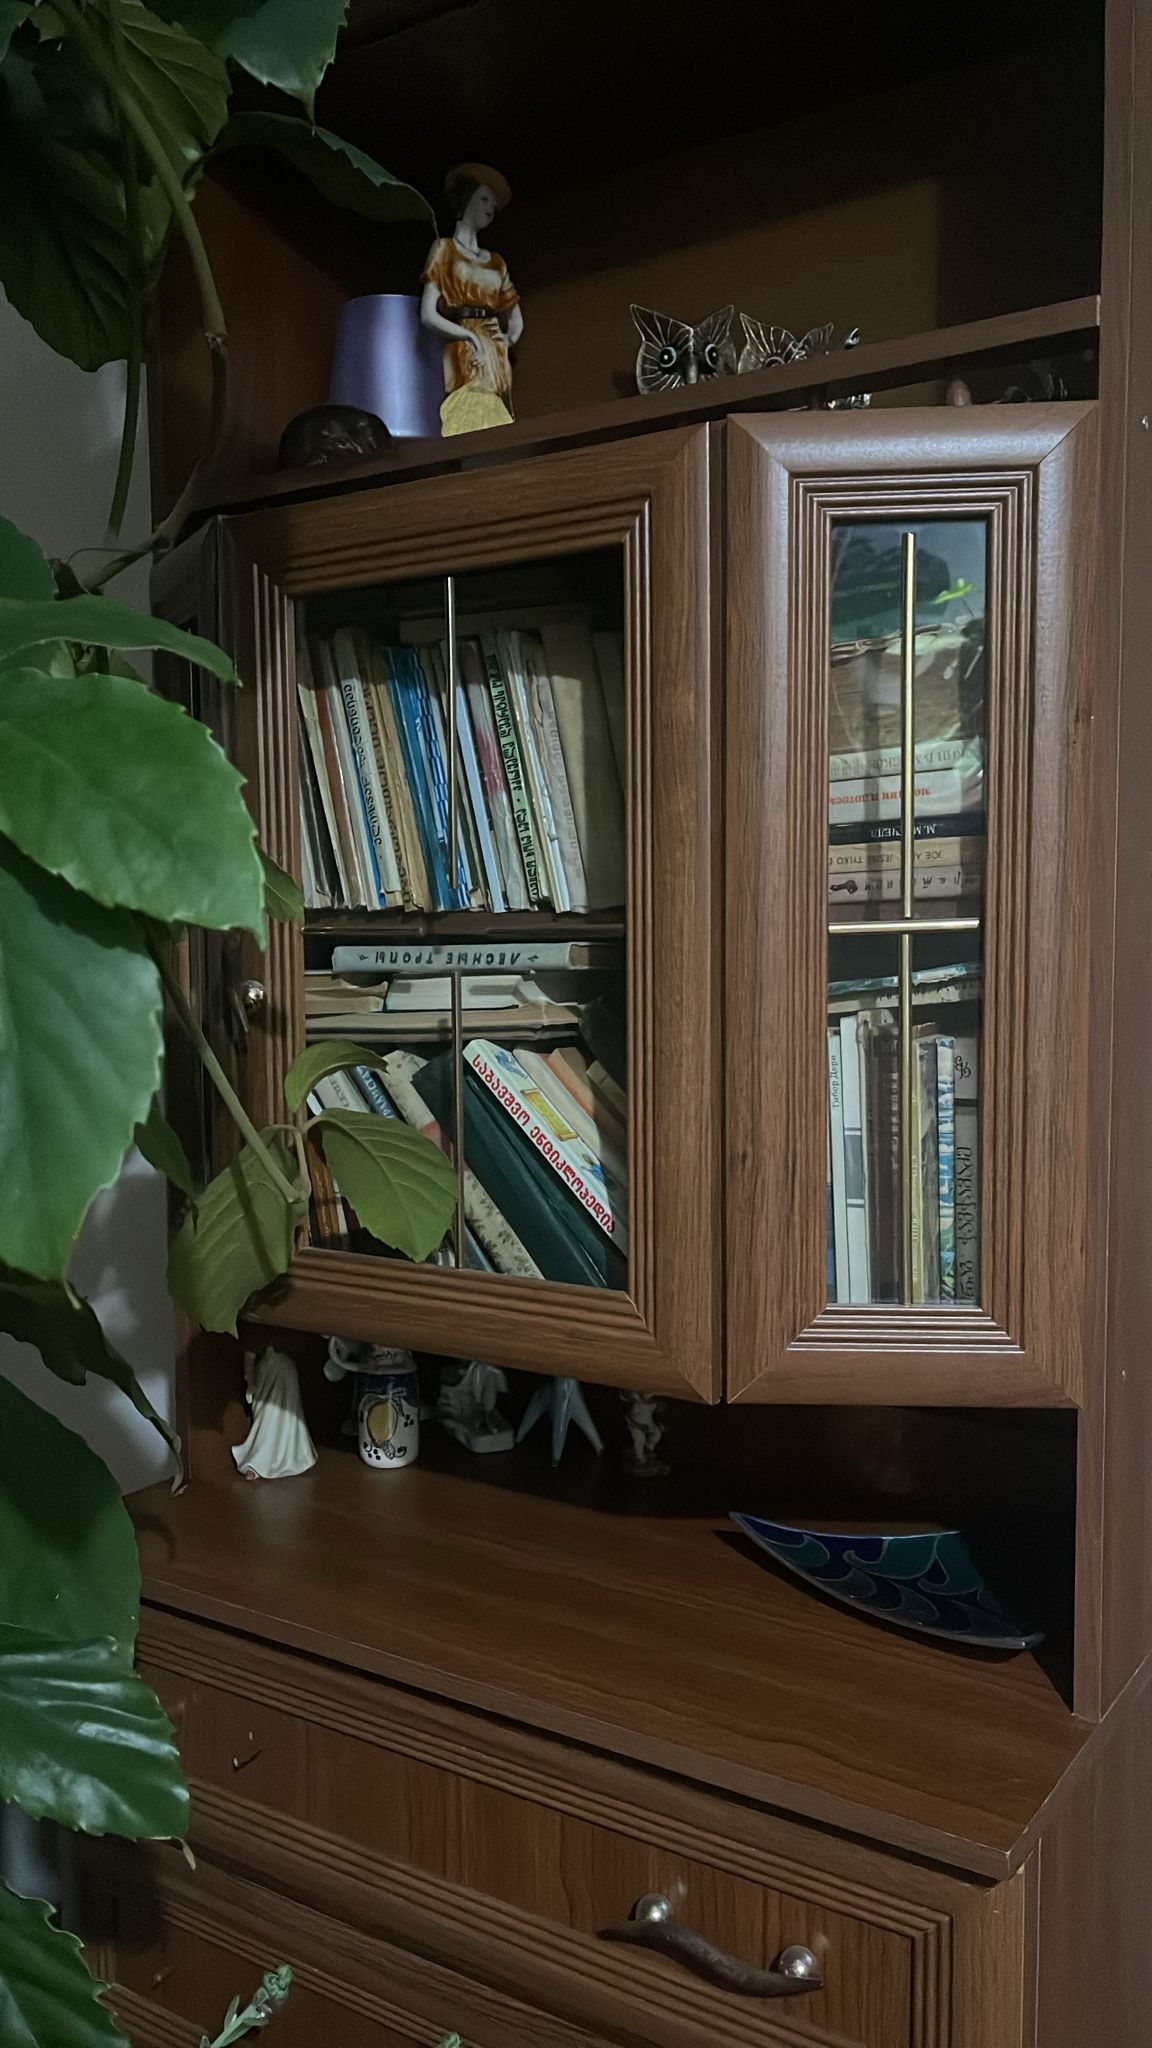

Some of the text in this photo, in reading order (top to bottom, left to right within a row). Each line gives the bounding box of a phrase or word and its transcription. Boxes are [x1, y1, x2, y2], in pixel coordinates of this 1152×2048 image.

[515, 808, 529, 832] სელა
[836, 856, 862, 866] TYLKO
[375, 950, 520, 965] ЛЕСНЫЕ ТРОПЫ
[829, 1055, 839, 1108] Тибор Дери
[471, 1054, 616, 1234] საბავშვო ენციკლოპედია
